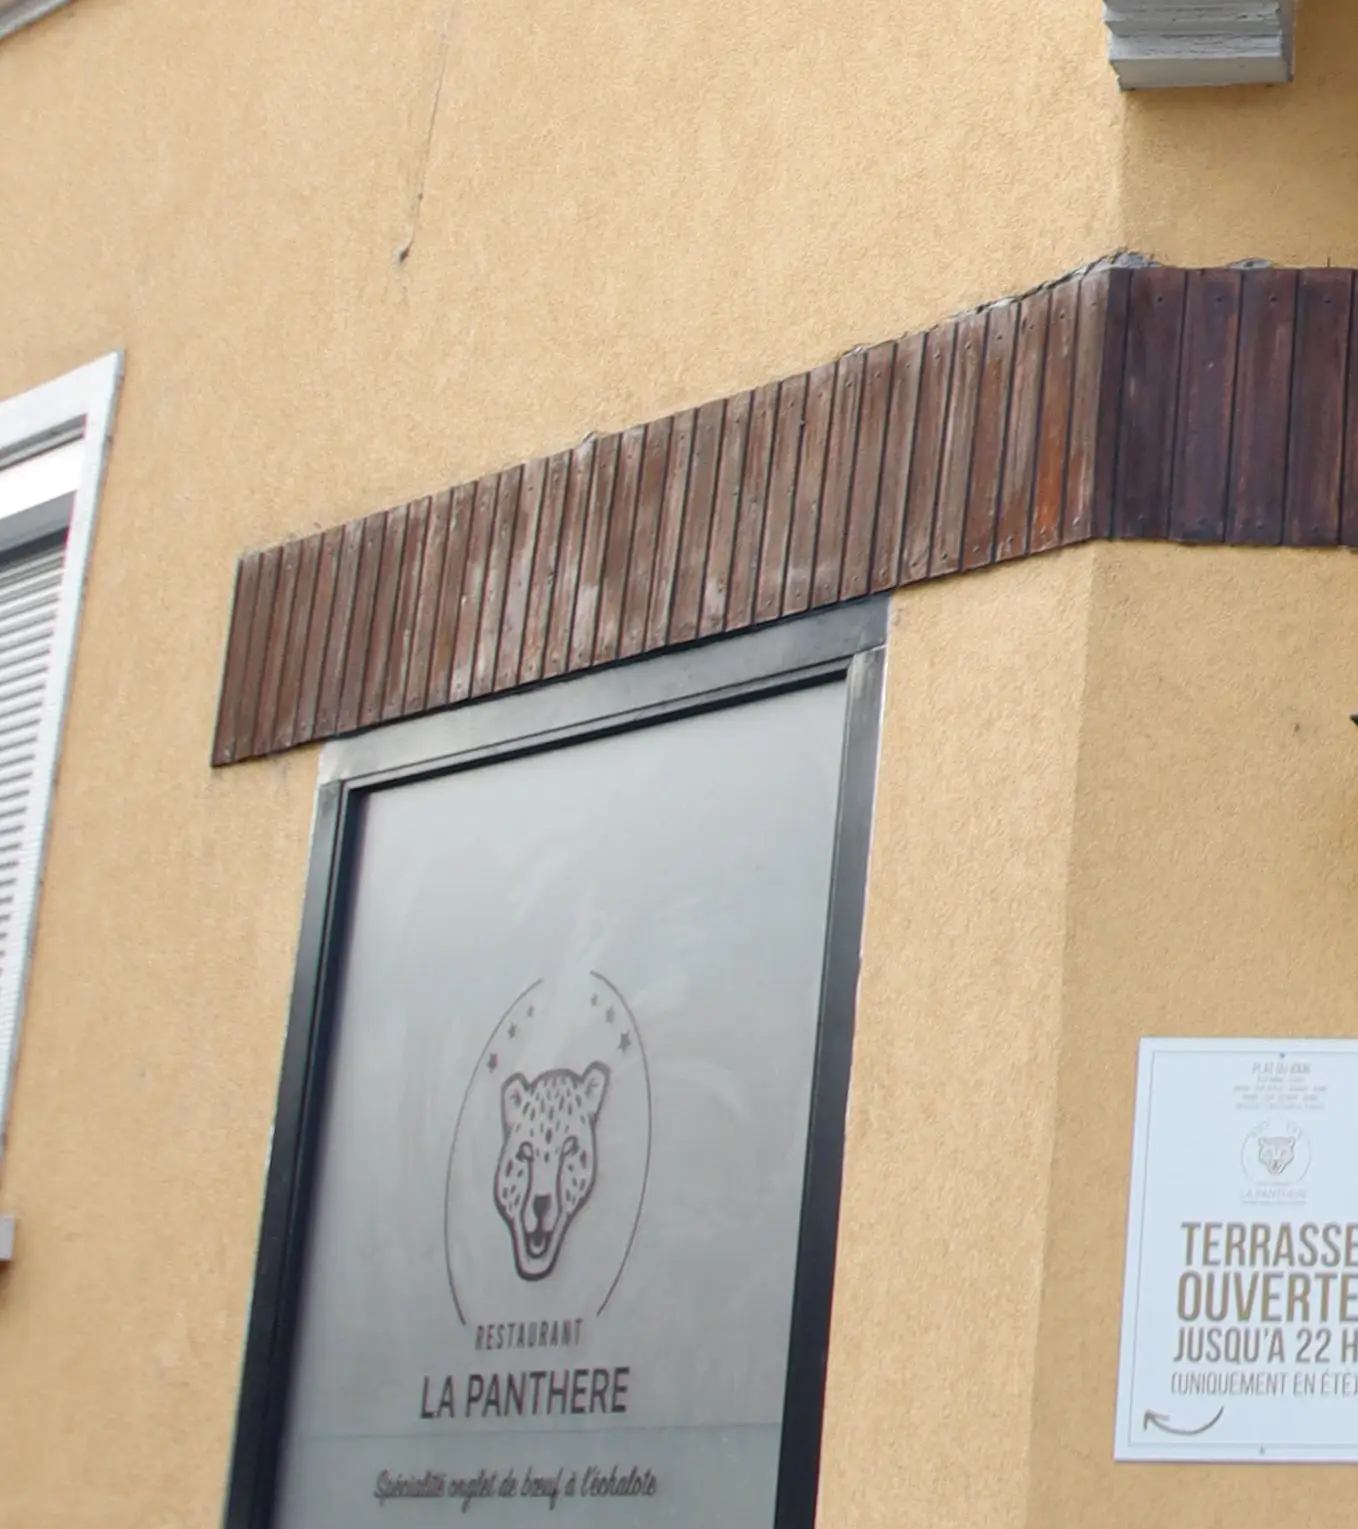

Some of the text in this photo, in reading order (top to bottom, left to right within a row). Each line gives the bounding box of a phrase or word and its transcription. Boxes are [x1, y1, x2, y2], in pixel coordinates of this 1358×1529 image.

[474, 1318, 584, 1351] RESTAURANT
[419, 1366, 631, 1419] LA PANTHERE
[1170, 1370, 1288, 1396] (UNIQUEMENT
[1292, 1371, 1317, 1397] EN
[449, 1469, 499, 1514] onglet
[498, 1467, 519, 1498] de
[564, 1470, 577, 1497] à
